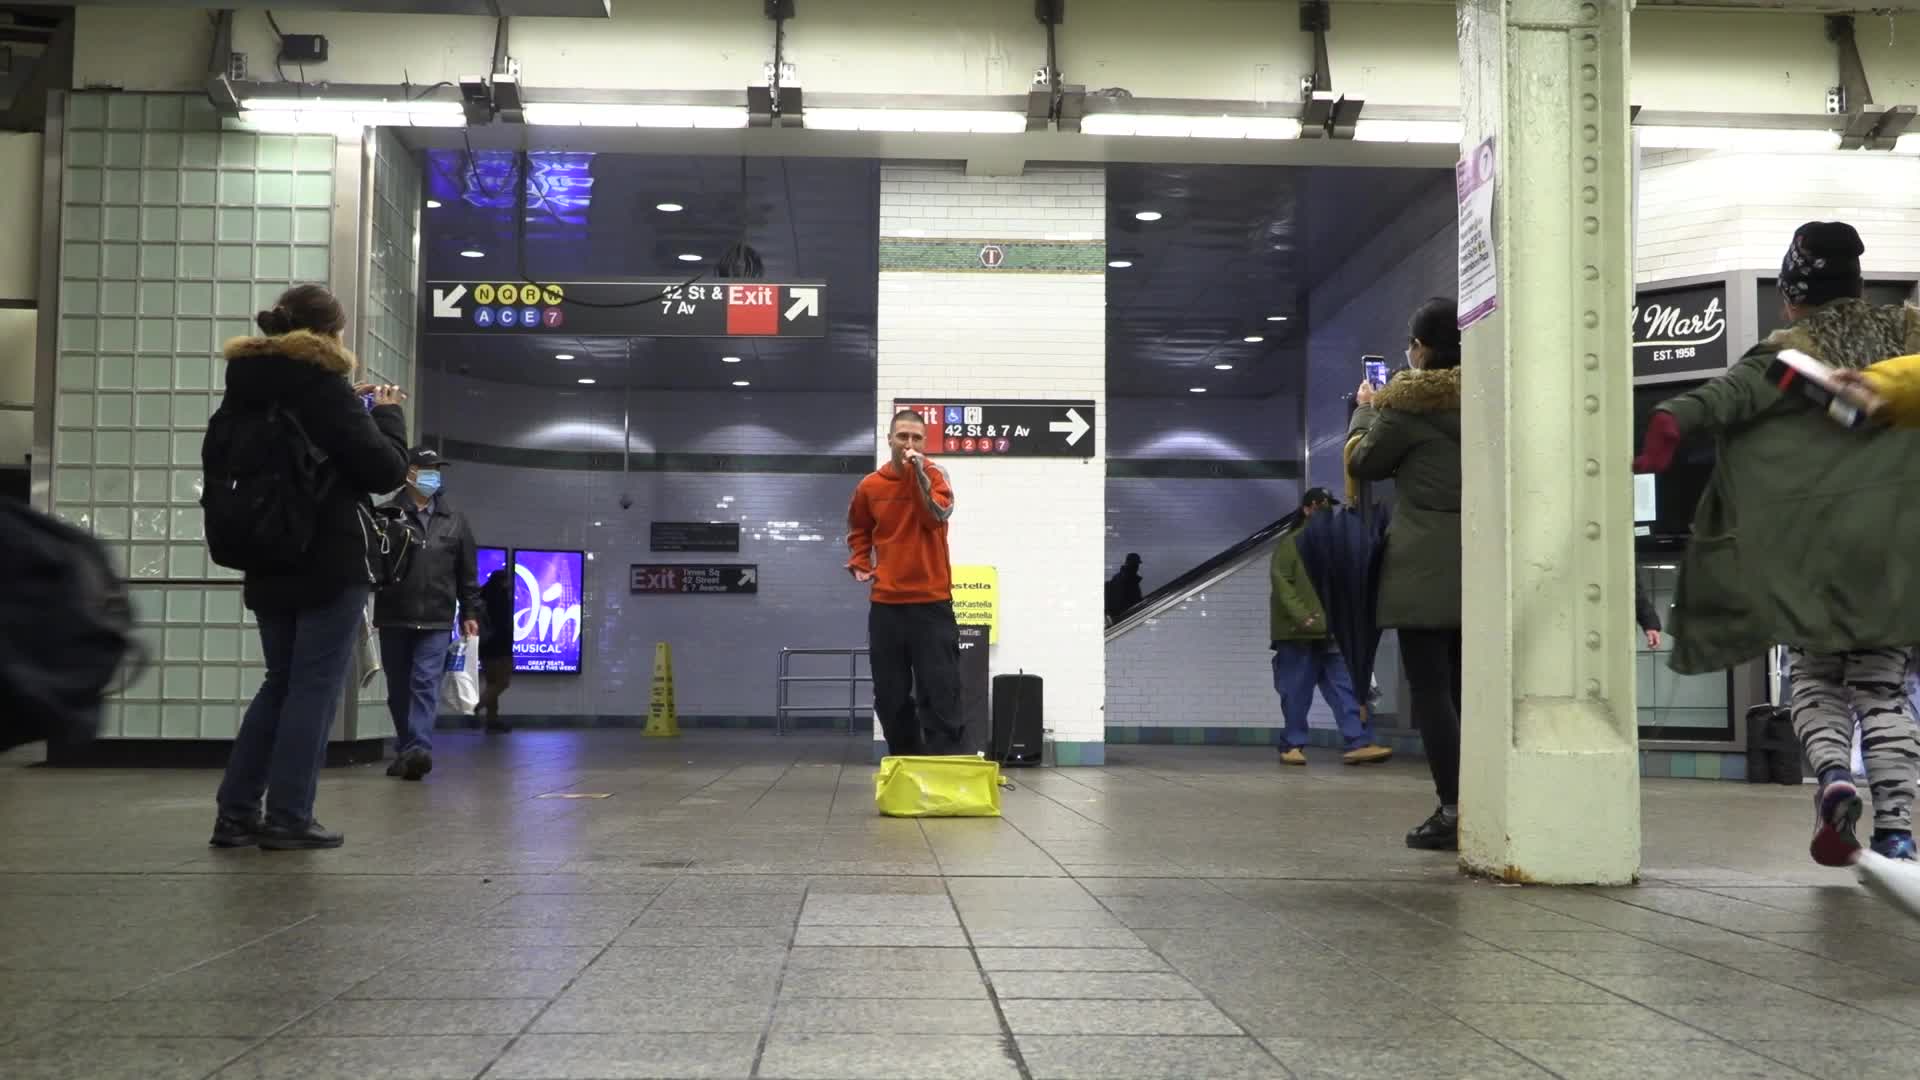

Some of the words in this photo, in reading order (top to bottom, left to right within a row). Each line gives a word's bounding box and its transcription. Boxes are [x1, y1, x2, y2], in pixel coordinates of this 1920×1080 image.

[985, 249, 998, 264] T
[479, 289, 490, 300] N
[502, 288, 513, 300] Q
[526, 289, 536, 300] R
[662, 285, 683, 300] 42
[688, 285, 706, 300] St
[711, 286, 723, 300] &
[729, 286, 772, 305] Exit
[661, 301, 672, 314] 7
[676, 301, 696, 314] Av
[479, 310, 490, 322] A
[502, 310, 513, 323] C
[525, 311, 535, 323] E
[548, 312, 558, 324] 7
[1643, 297, 1725, 339] Mart
[1653, 349, 1673, 361] EST.
[1674, 347, 1696, 359] 1958
[945, 425, 962, 437] 42
[967, 425, 982, 437] St
[986, 425, 997, 437] &
[1001, 425, 1010, 437] 7
[1014, 425, 1030, 437] Av
[965, 440, 973, 450] 2
[981, 440, 990, 450] 3
[631, 568, 675, 588] Exit
[682, 568, 706, 577] Times
[682, 576, 693, 584] 42
[696, 576, 720, 584] Street
[512, 644, 562, 654] MUSICAL
